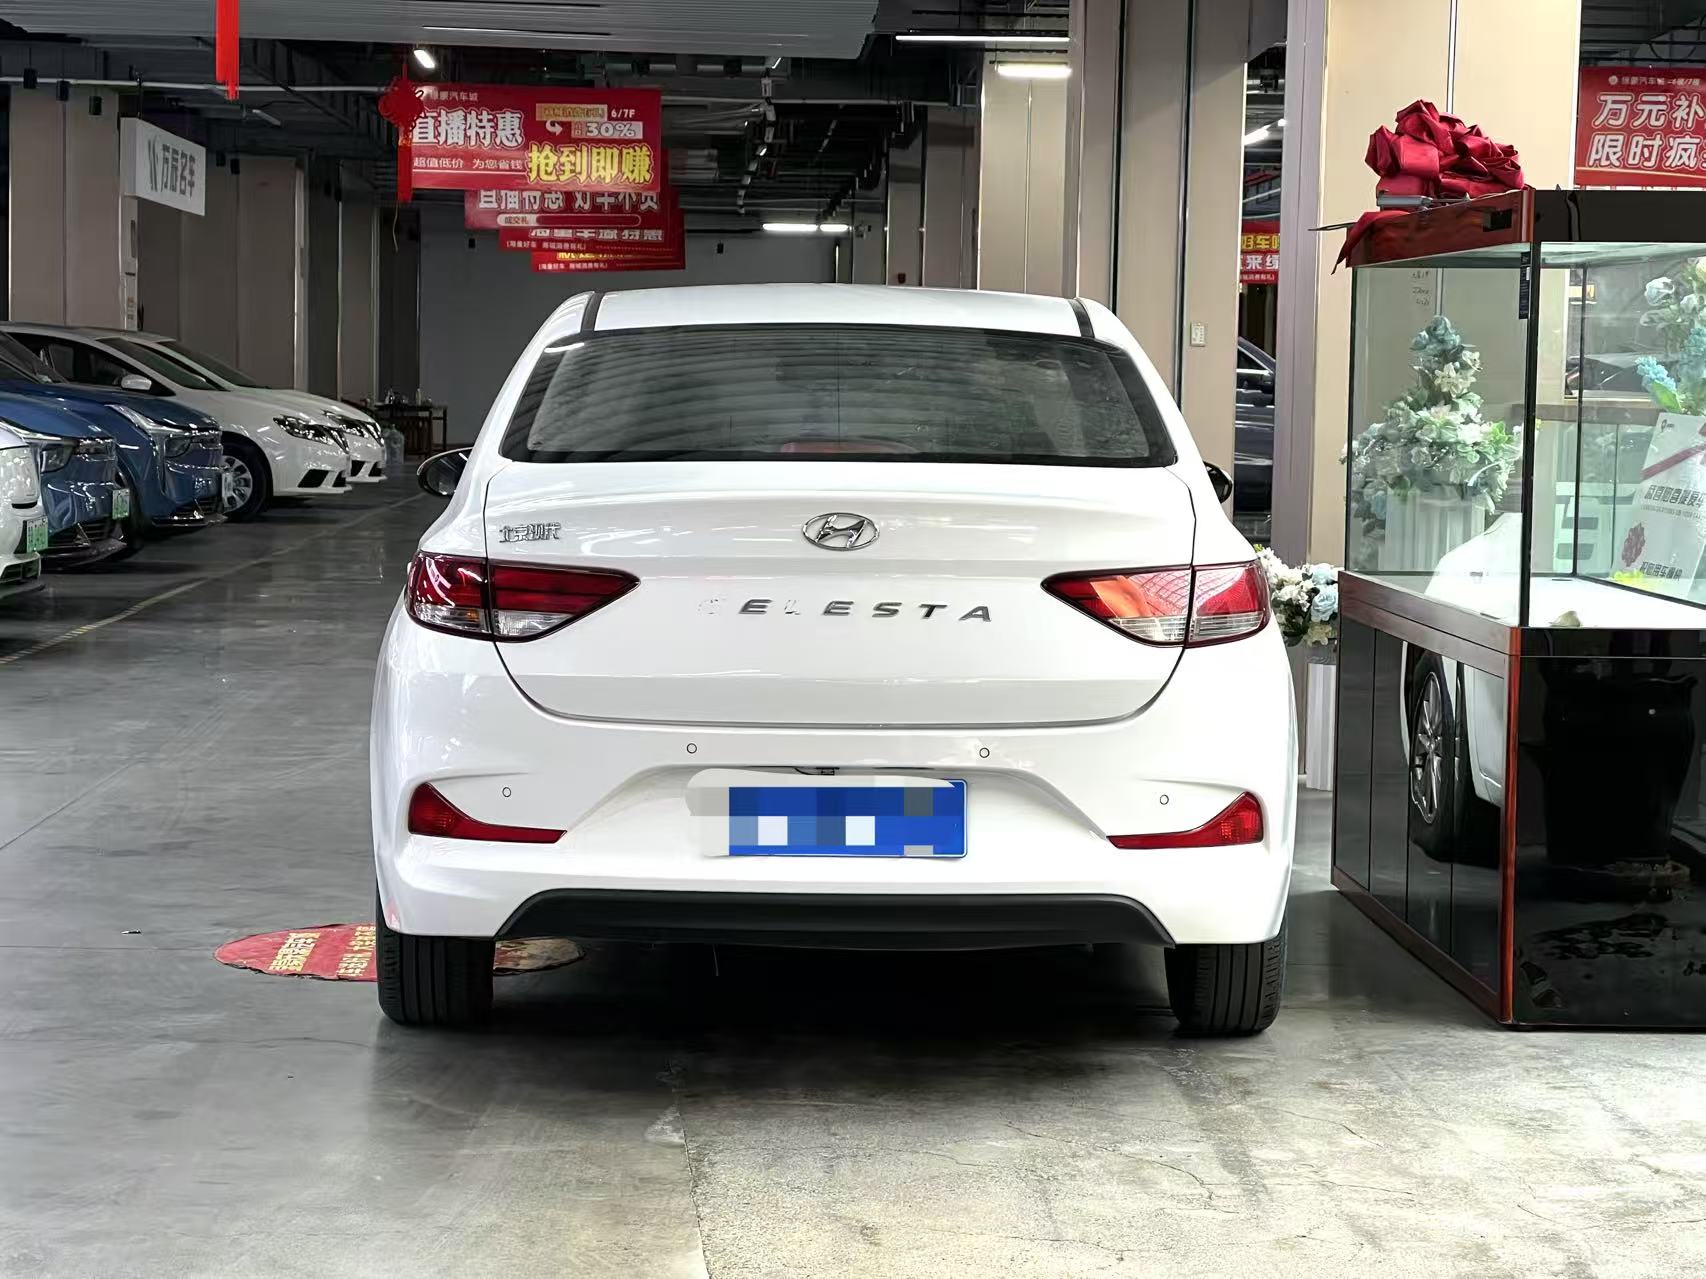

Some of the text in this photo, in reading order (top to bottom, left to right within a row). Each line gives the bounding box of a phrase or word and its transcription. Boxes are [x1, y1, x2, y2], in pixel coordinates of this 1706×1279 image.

[611, 108, 636, 119] 6/7F
[412, 108, 523, 148] 直播特惠
[586, 121, 636, 138] 30%
[413, 156, 523, 170] 超值低价 为您省钱
[527, 143, 652, 183] 抢到即赚
[499, 522, 561, 543] 北京现代
